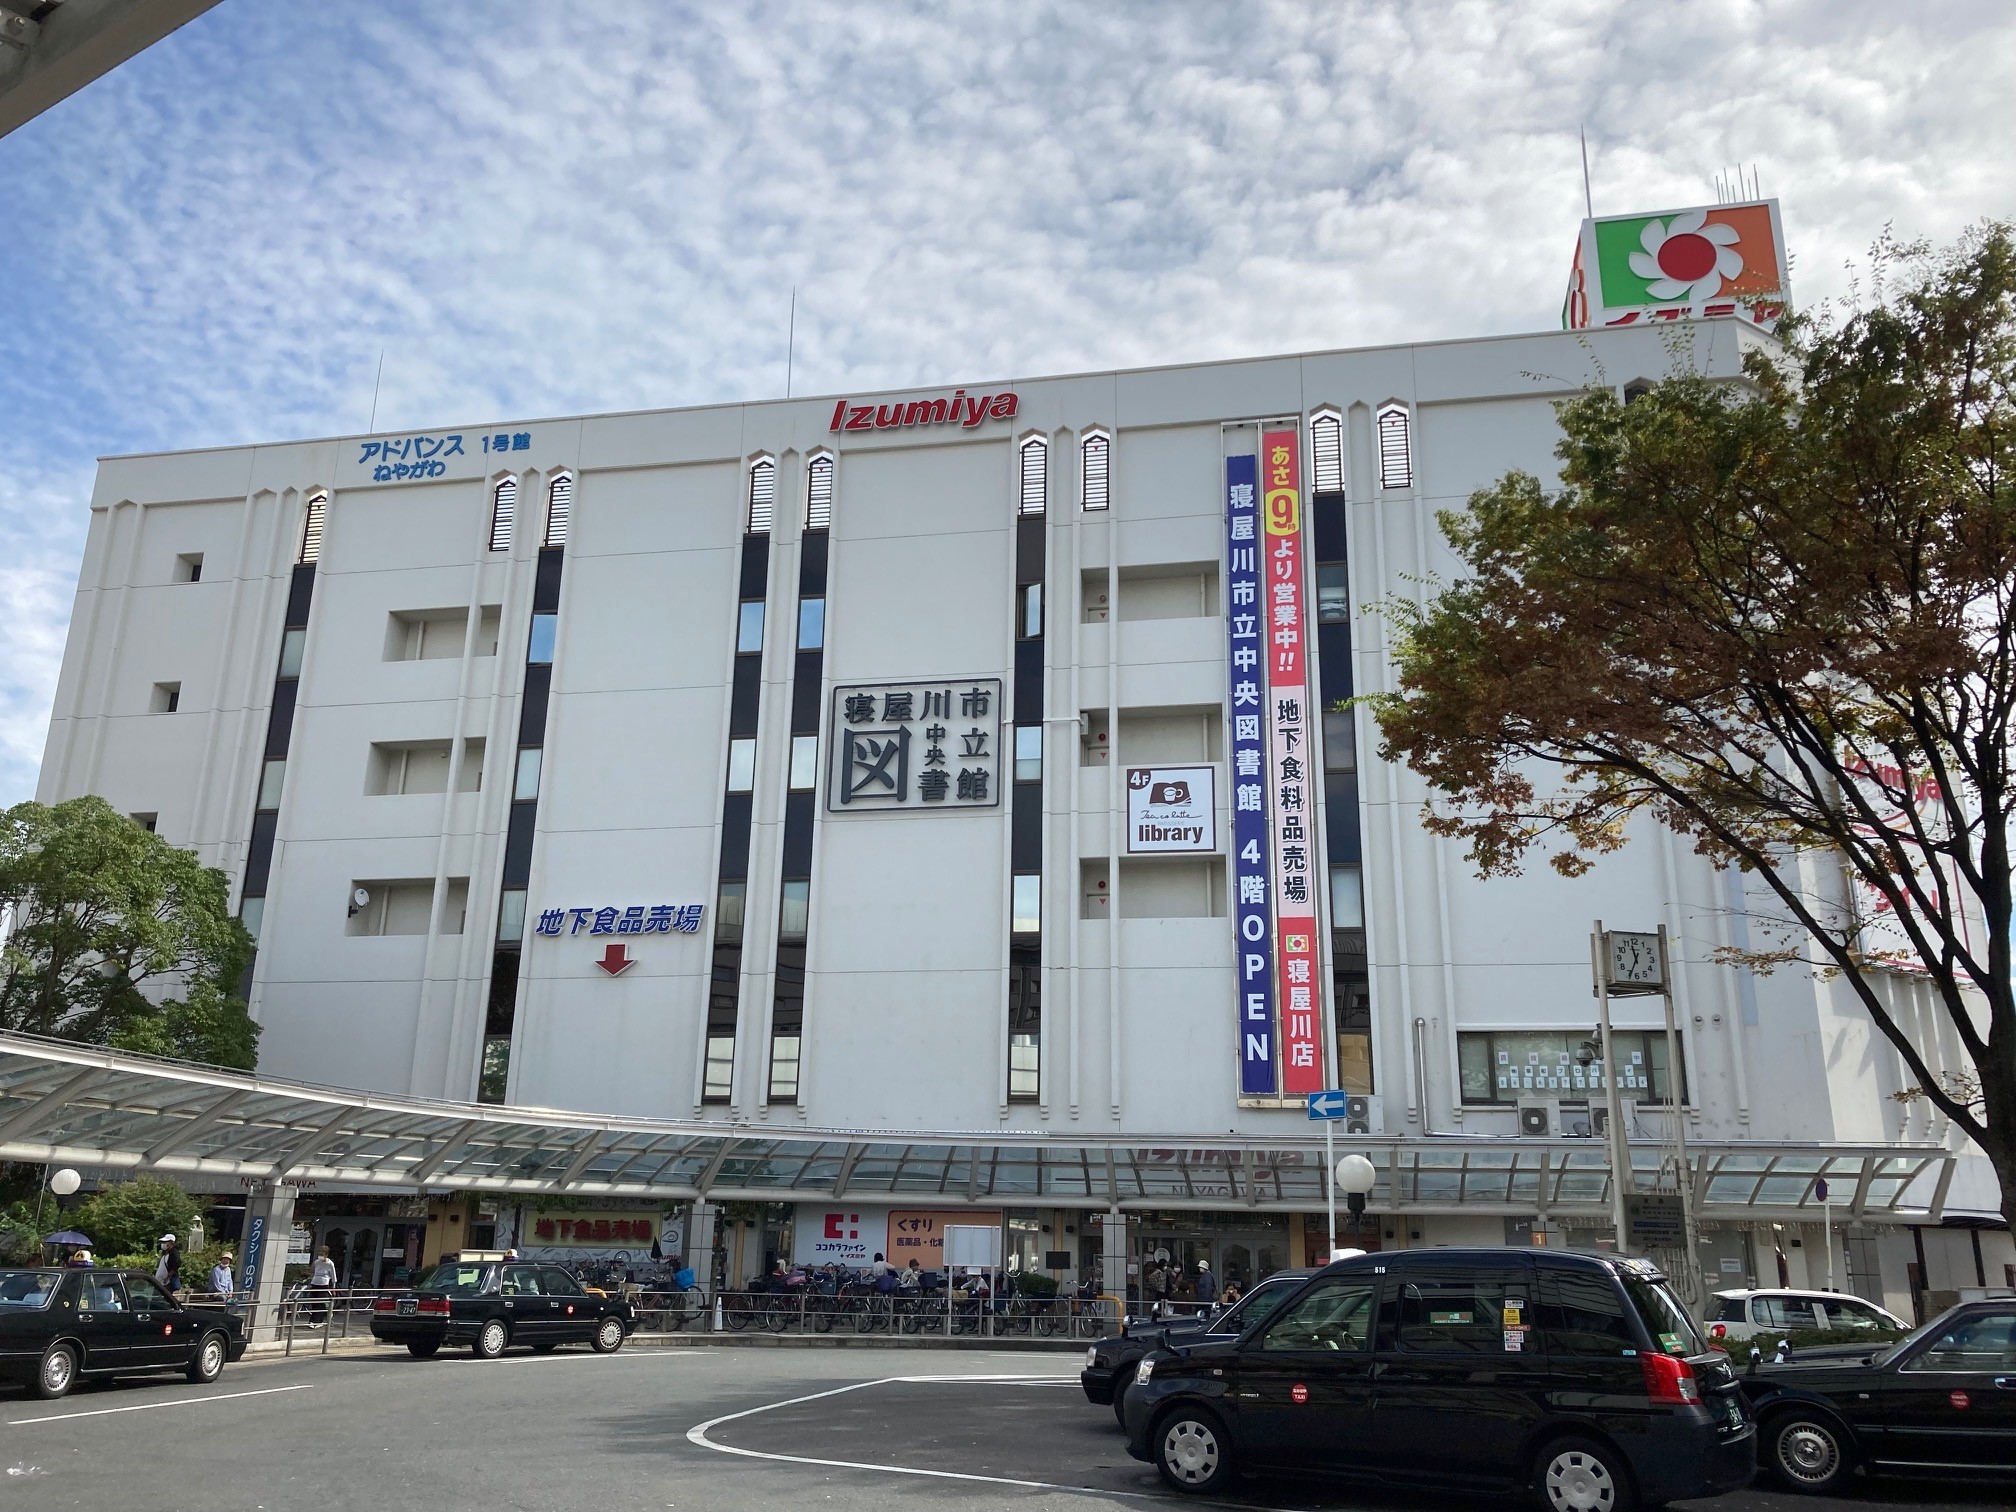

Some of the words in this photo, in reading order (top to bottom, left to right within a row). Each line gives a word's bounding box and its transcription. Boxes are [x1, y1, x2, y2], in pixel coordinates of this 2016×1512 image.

[829, 390, 1019, 433] Izumiya
[359, 435, 465, 464] アドバンス
[481, 432, 532, 454] 1号館
[373, 459, 446, 482] ねやがわ
[1130, 771, 1149, 786] 4F
[1277, 699, 1307, 904] 地下食料品売場
[1138, 824, 1204, 844] library
[535, 904, 704, 936] 地下食品売場
[1287, 958, 1315, 1067] 寝屋川店
[535, 1218, 650, 1240] 地下食品売場
[897, 1218, 933, 1232] くすり
[815, 1243, 867, 1252] ココカラファイン
[1374, 1266, 1386, 1274] 515
